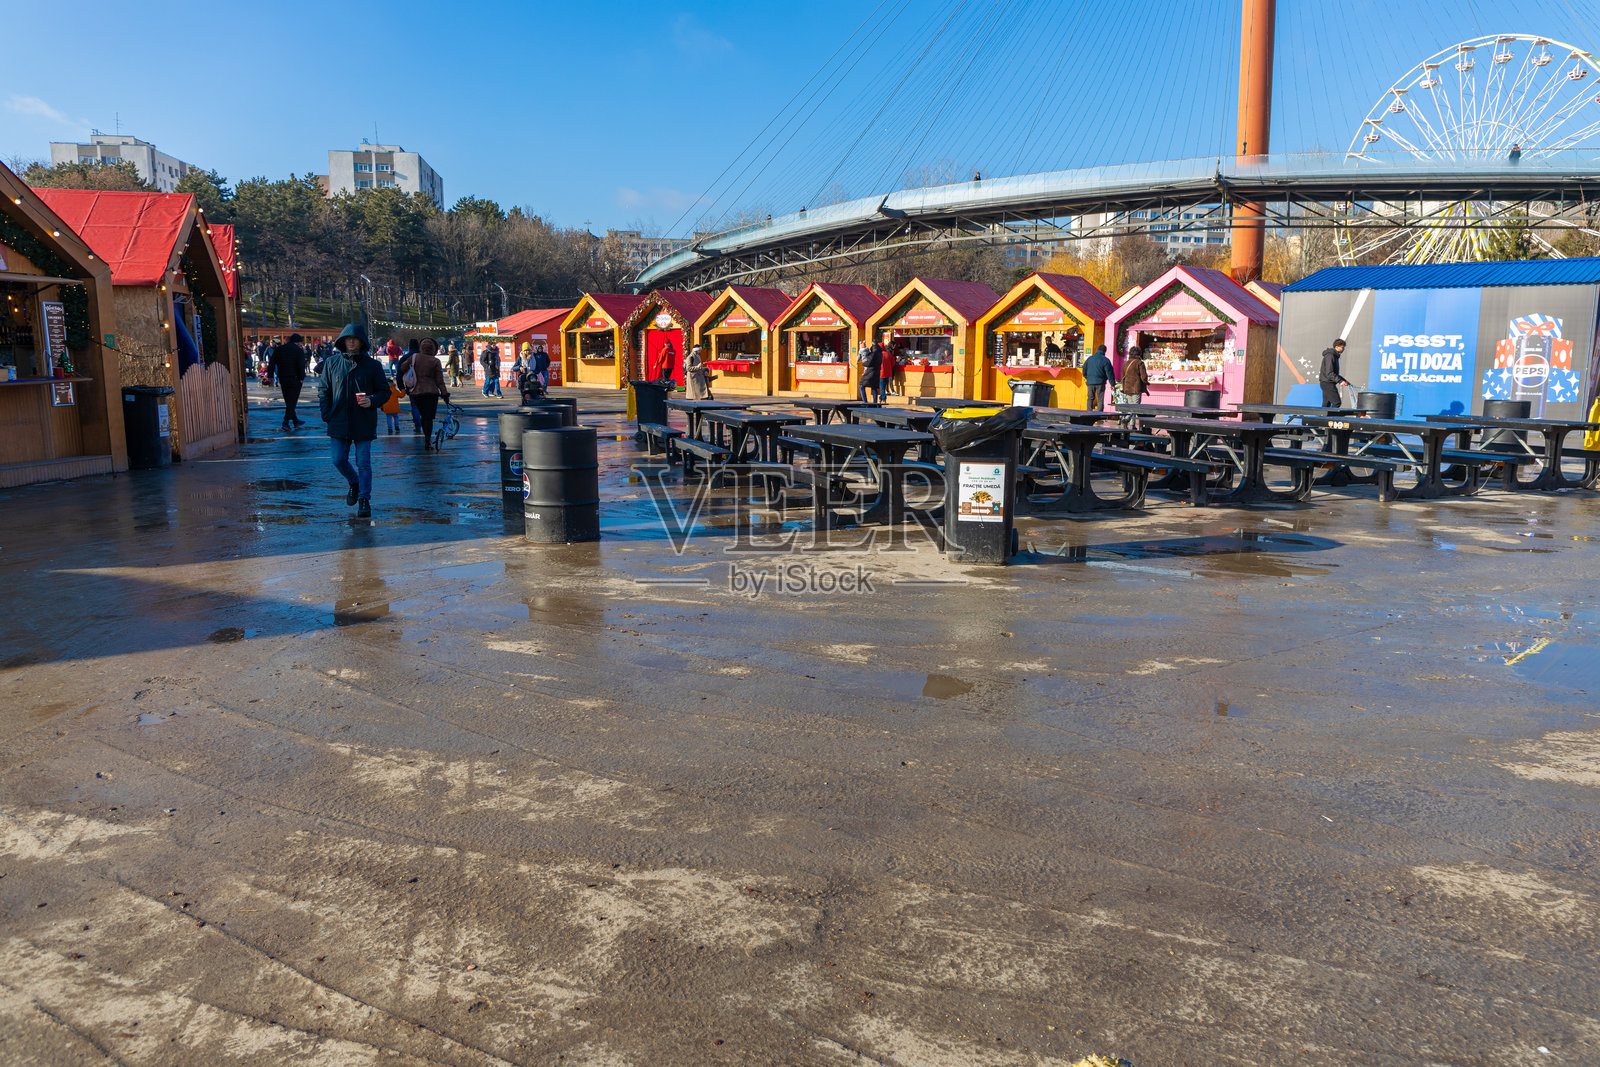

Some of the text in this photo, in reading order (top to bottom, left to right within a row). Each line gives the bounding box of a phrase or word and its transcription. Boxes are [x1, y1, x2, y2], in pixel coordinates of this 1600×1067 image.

[1383, 334, 1465, 351] PSSST,
[1420, 352, 1463, 371] DOZA
[1380, 373, 1399, 382] DE
[1515, 367, 1547, 375] PEPSI
